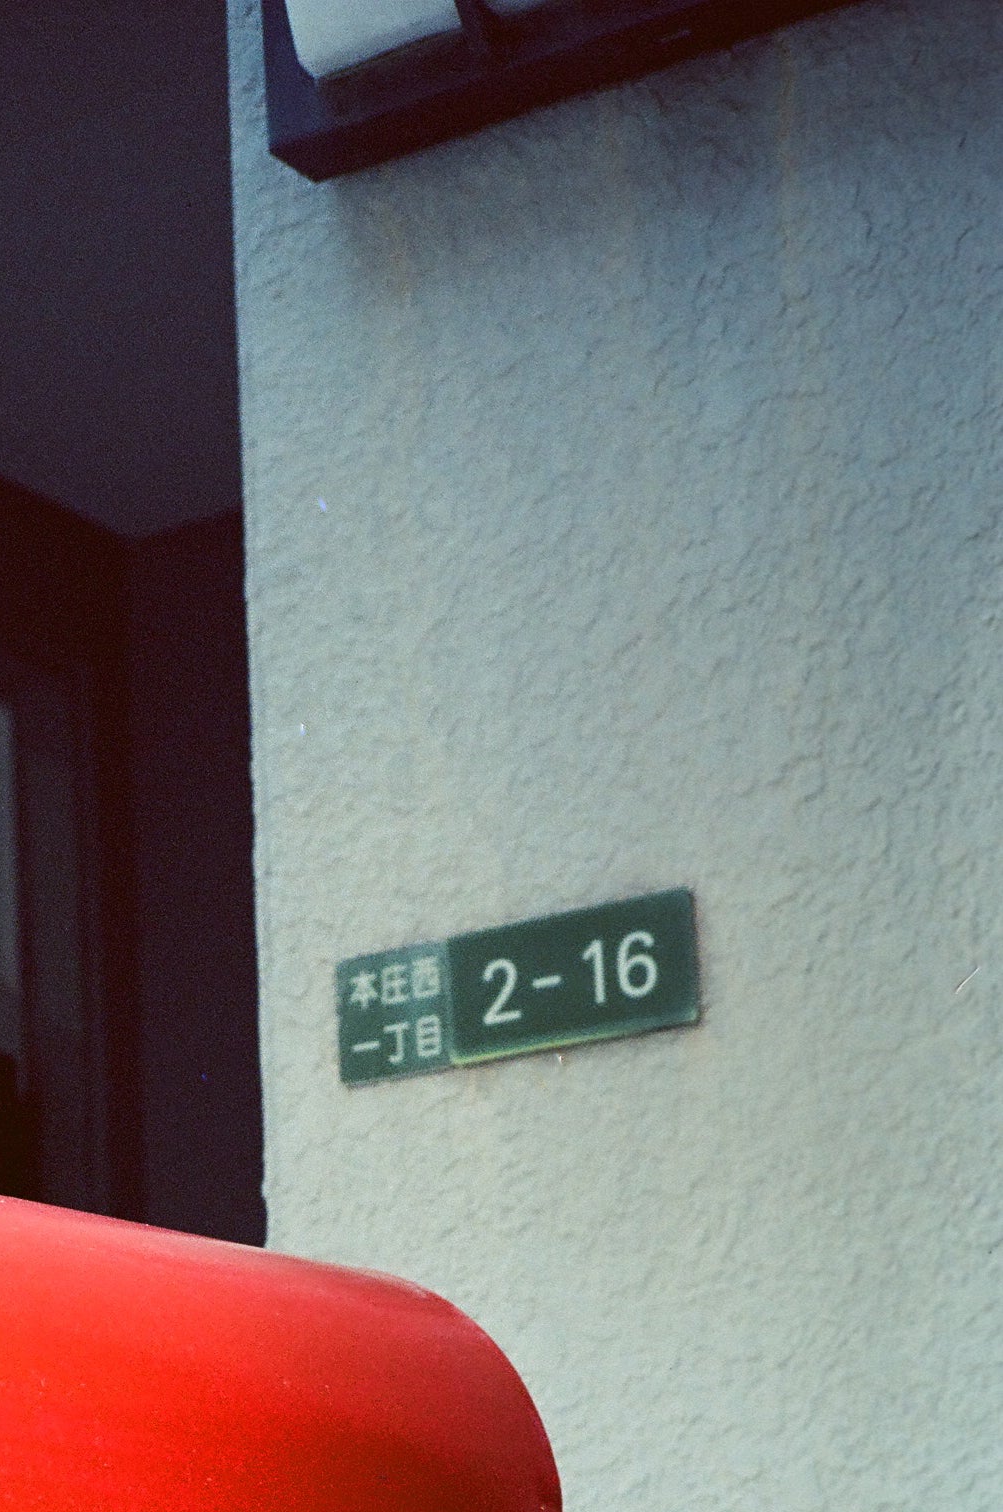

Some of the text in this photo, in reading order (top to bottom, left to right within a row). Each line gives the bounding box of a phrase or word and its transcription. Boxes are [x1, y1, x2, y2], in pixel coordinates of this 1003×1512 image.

[482, 930, 658, 1025] 2-16
[351, 1014, 442, 1064] 一丁目
